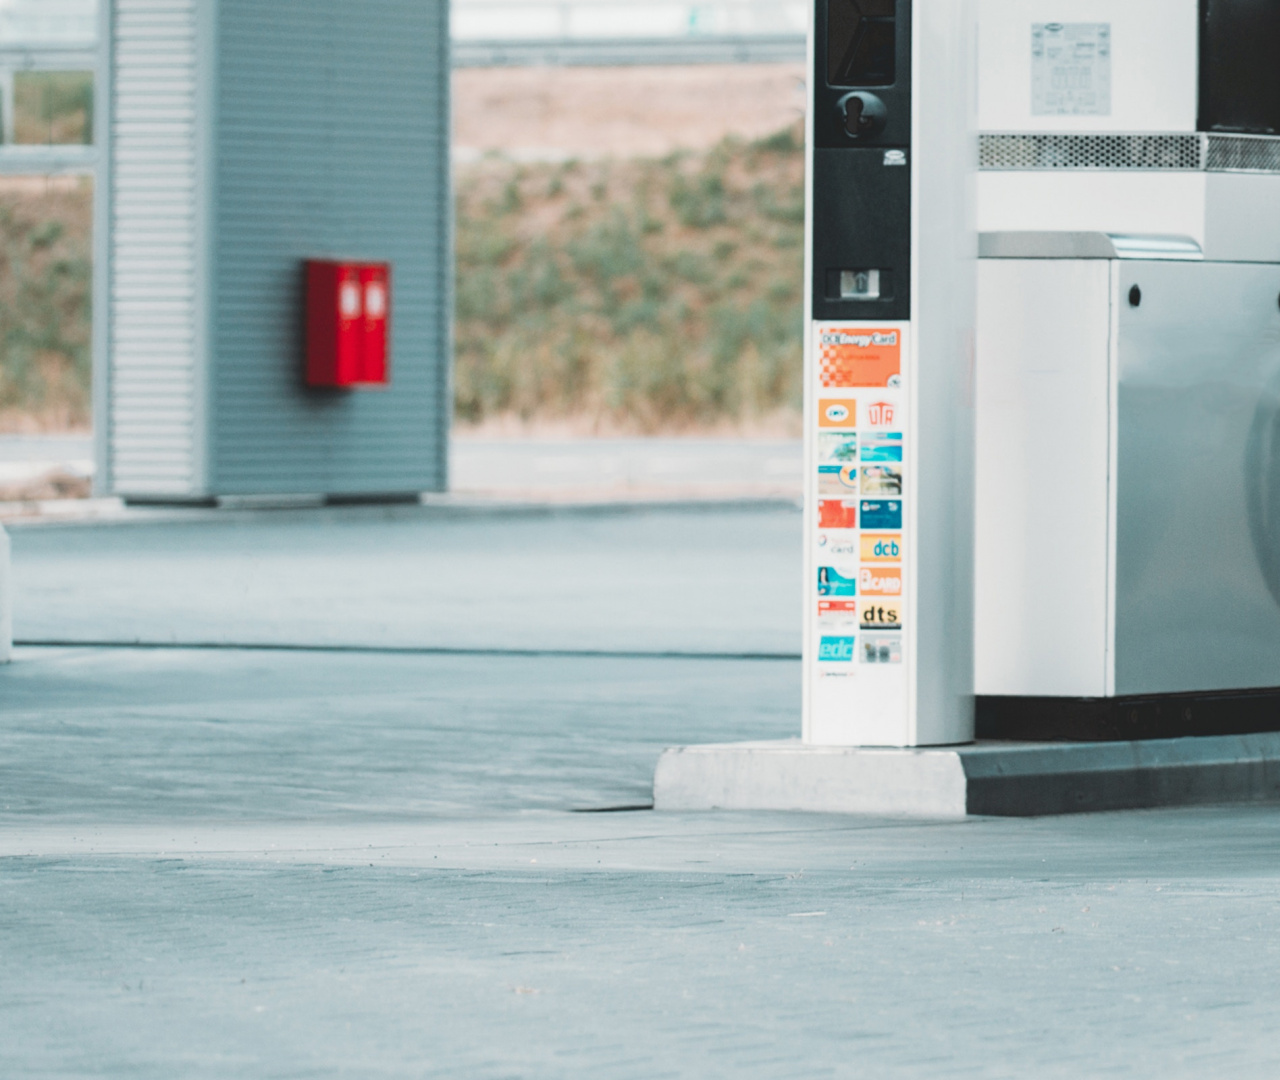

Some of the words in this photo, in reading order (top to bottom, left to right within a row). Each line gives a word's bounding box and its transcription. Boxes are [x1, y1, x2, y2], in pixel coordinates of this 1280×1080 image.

[869, 401, 894, 425] UTA
[874, 539, 899, 556] dcb
[863, 606, 897, 622] dts
[819, 639, 853, 658] edc
